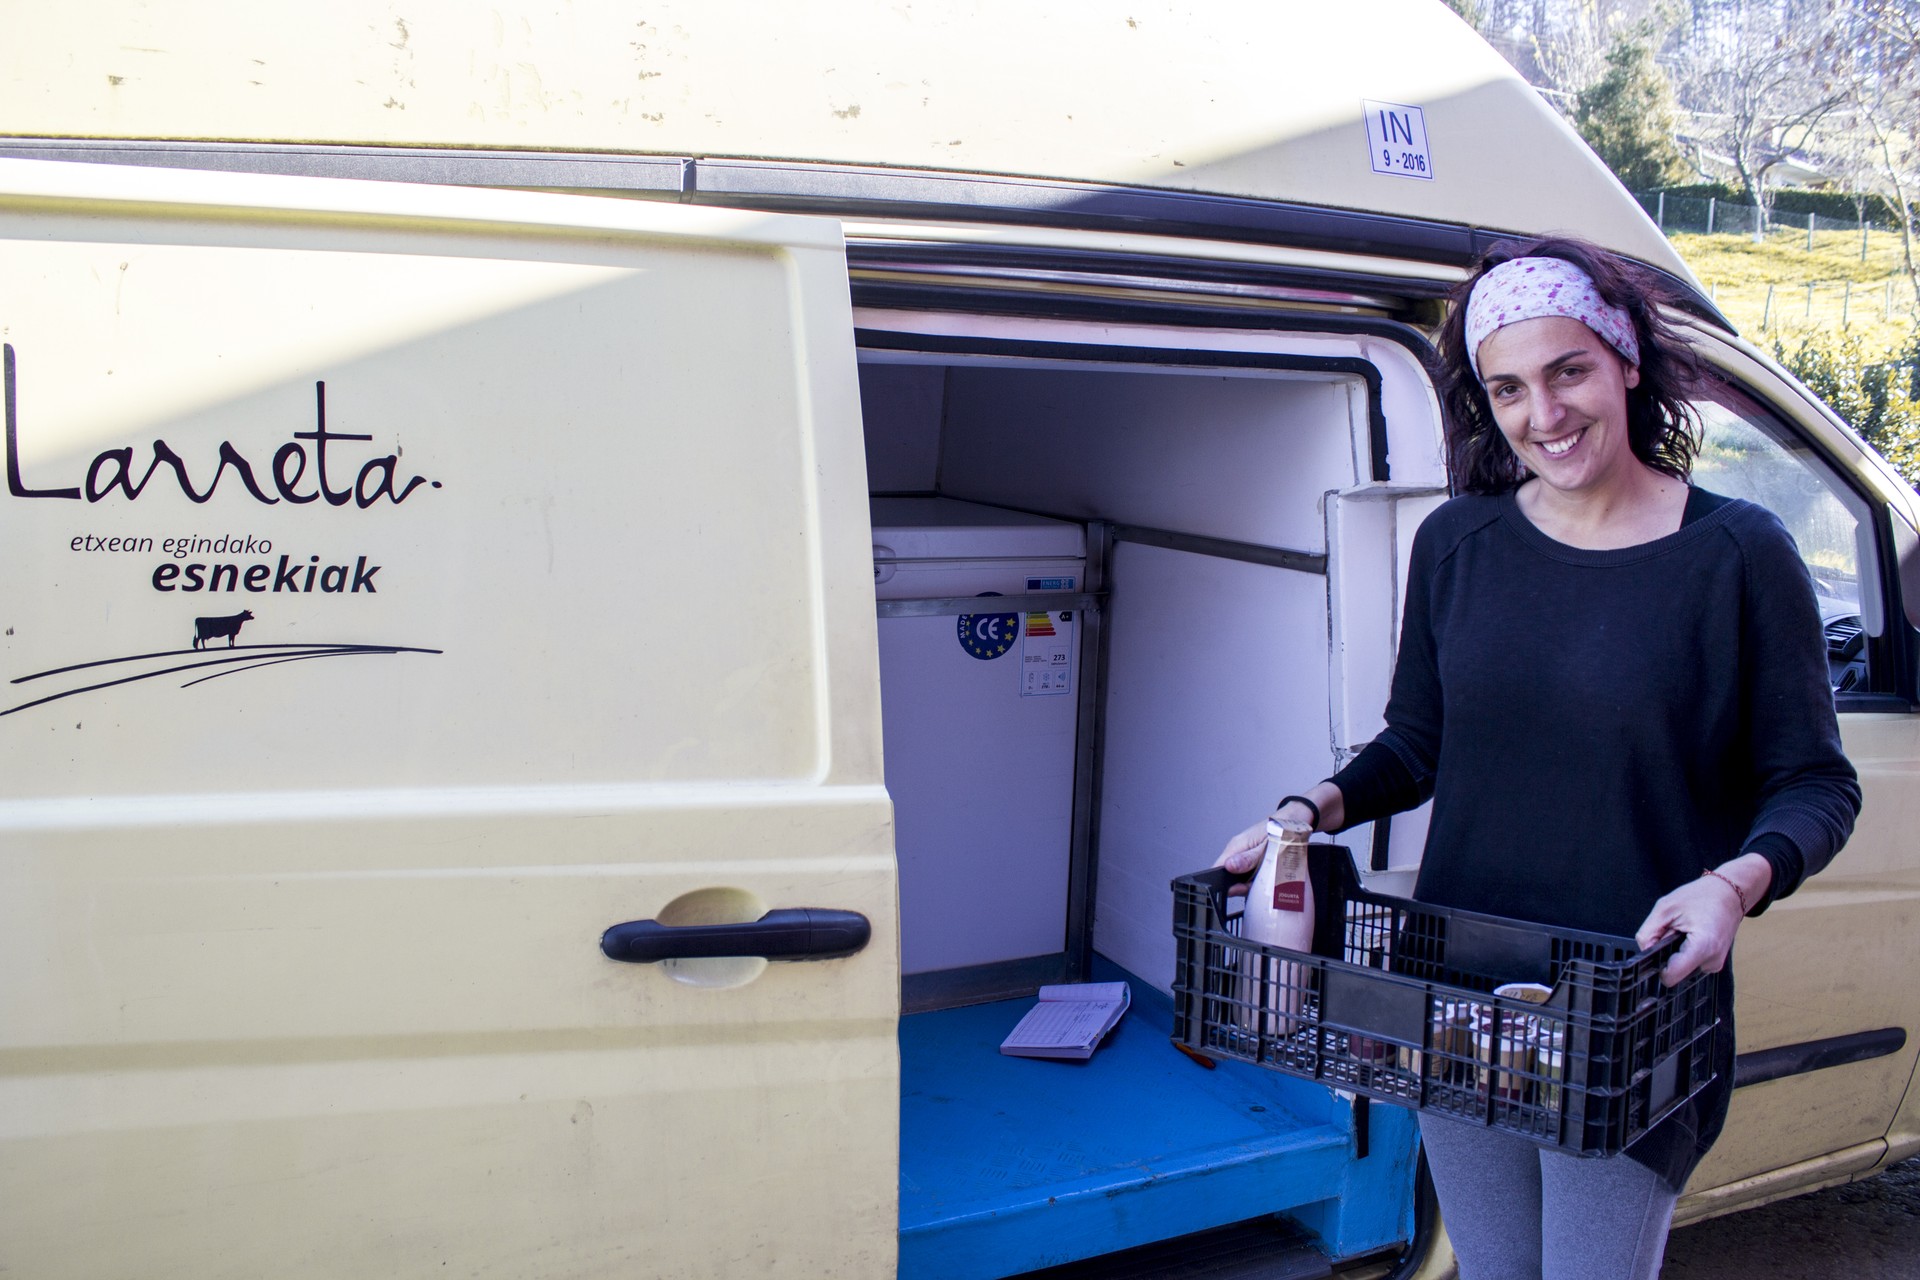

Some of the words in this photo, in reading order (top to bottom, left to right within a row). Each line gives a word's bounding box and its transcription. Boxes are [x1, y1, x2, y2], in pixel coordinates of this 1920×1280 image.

[1379, 110, 1413, 145] IN
[1383, 149, 1391, 167] 9
[1401, 152, 1426, 172] 2016
[70, 533, 153, 553] etxean
[162, 534, 273, 559] egindako
[151, 554, 382, 594] esnekiak
[976, 617, 1000, 641] CE
